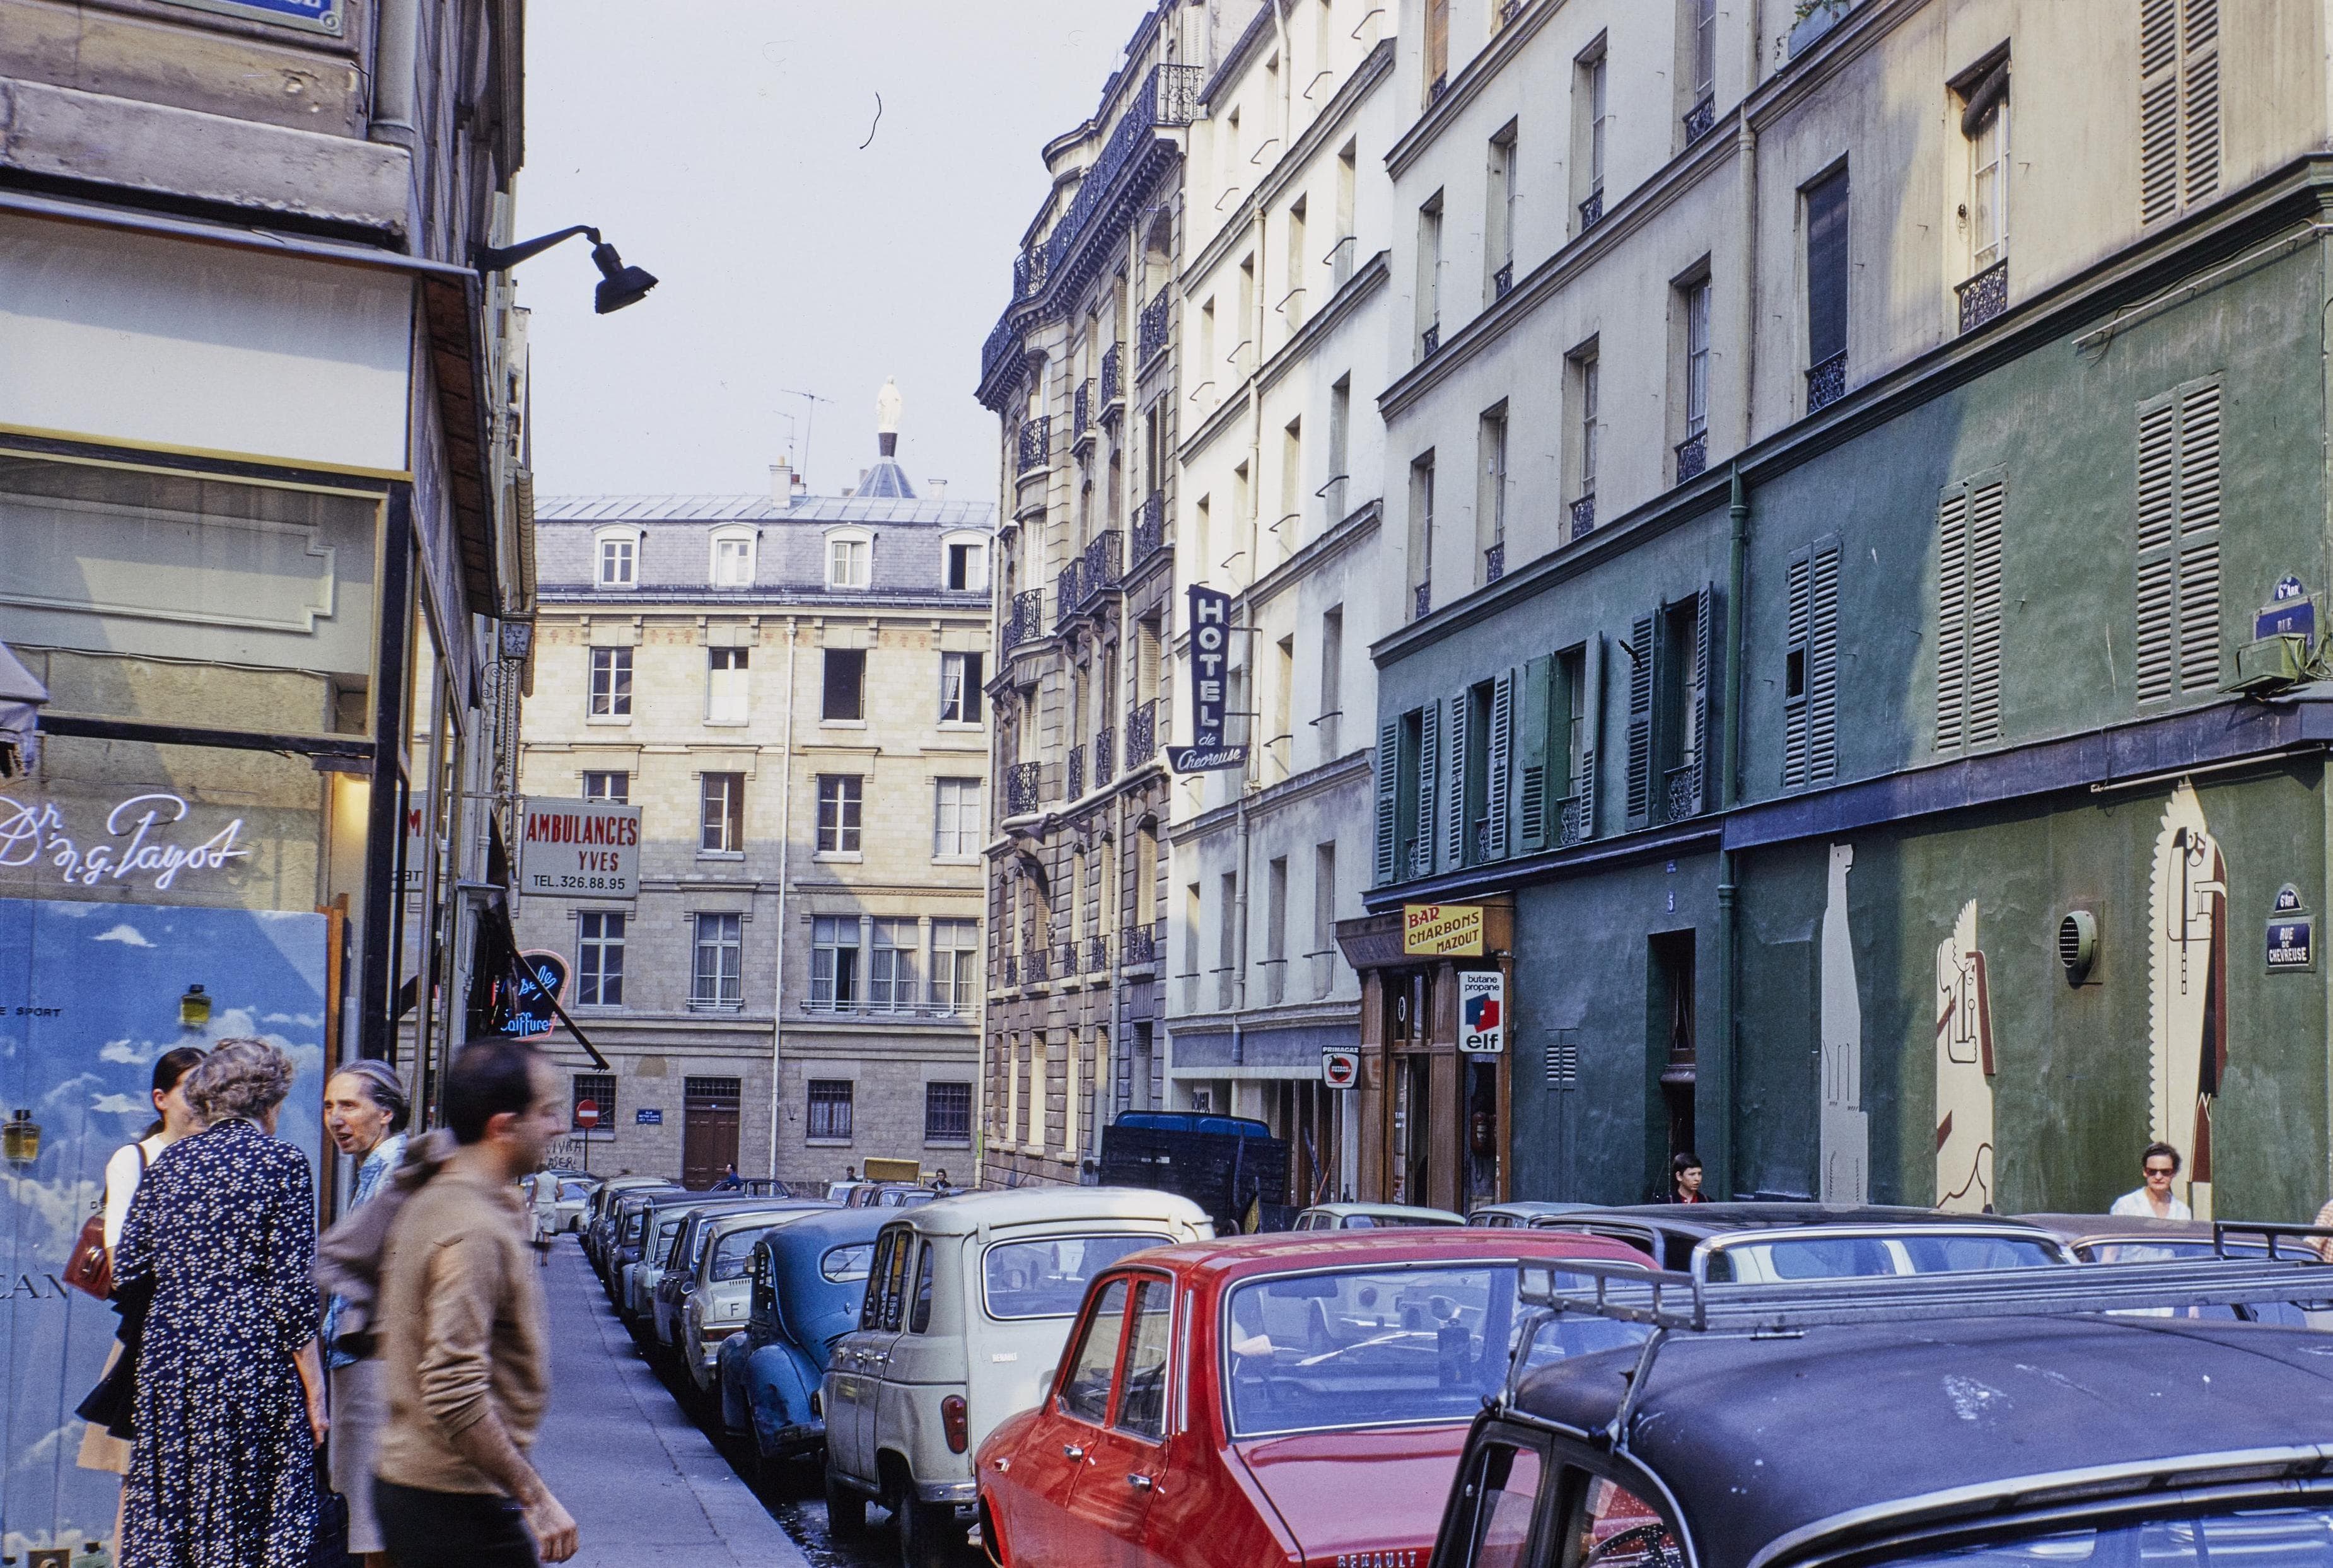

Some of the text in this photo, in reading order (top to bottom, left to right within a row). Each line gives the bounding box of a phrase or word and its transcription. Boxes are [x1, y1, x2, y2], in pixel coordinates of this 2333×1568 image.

[1199, 598, 1223, 727] HOTEL
[1198, 733, 1216, 745] de
[526, 813, 637, 846] AMBULANCES
[106, 793, 250, 890] Payot
[578, 851, 619, 872] YVES
[533, 874, 625, 890] TEL.326.88.95
[1407, 907, 1440, 929] BAR
[1409, 912, 1479, 946] CHARBONS
[2279, 927, 2294, 941] RUE
[1436, 929, 1479, 954] MAZOUT
[2269, 947, 2307, 963] CHEVREUSE
[1467, 975, 1498, 984] butane
[1465, 984, 1499, 992] propane
[16, 1006, 62, 1017] SPORT
[1466, 1033, 1499, 1050] elf
[730, 1303, 740, 1316] F
[1337, 1552, 1417, 1568] RENAULT
